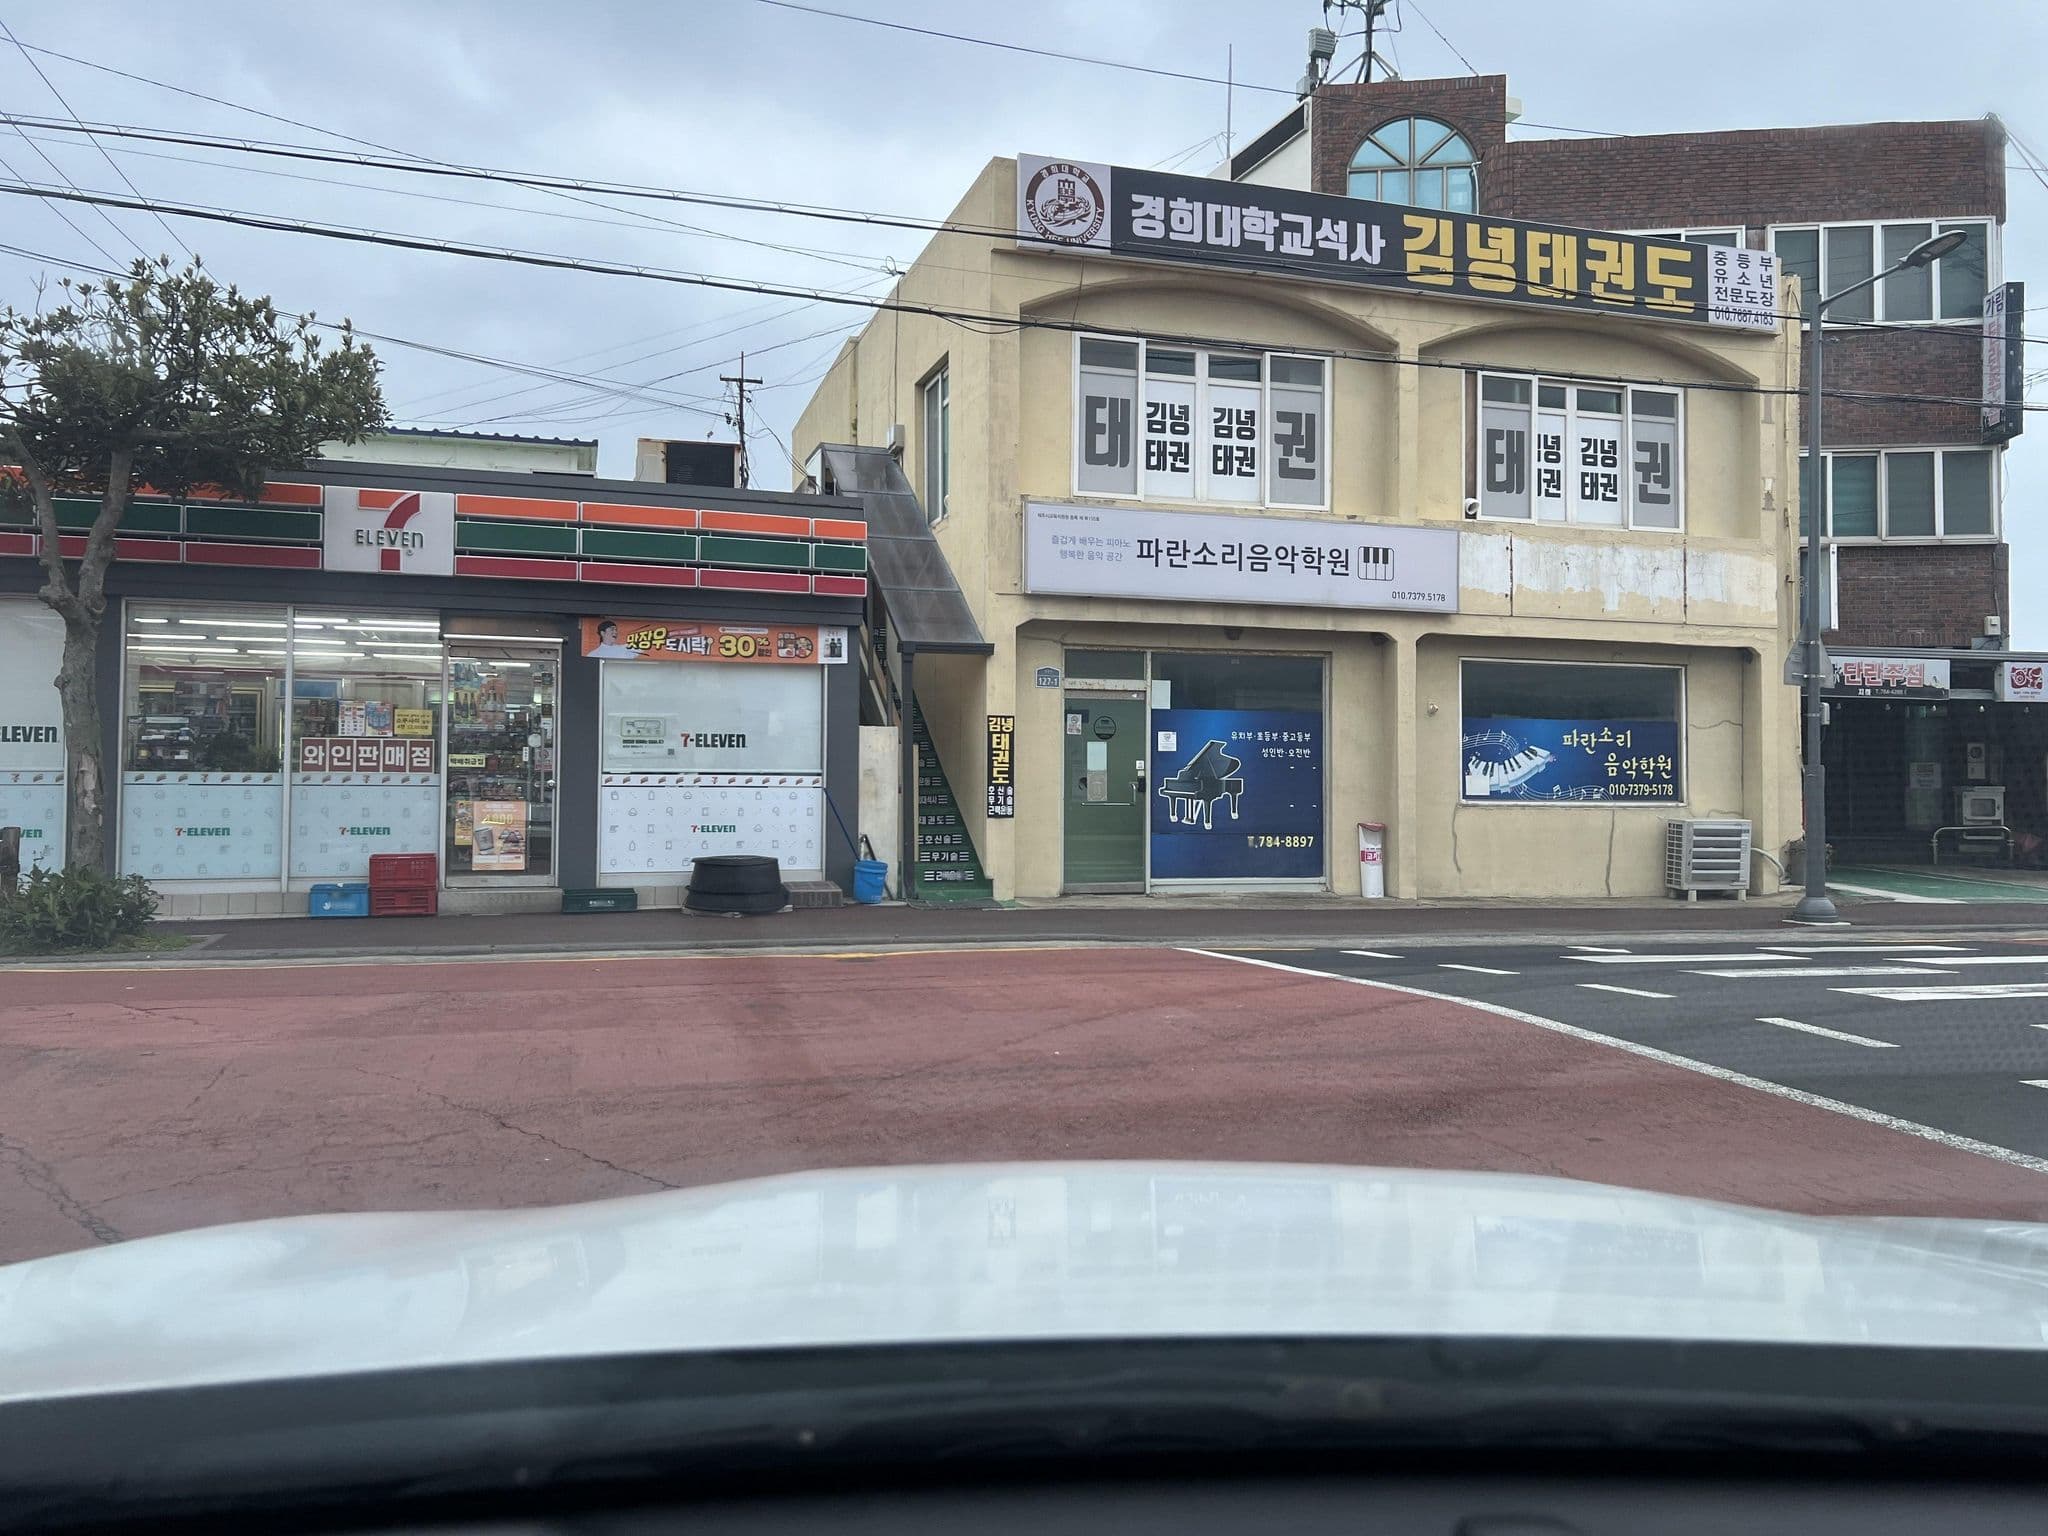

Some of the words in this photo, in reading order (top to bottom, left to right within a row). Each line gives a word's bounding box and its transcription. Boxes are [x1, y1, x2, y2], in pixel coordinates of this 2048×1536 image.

[1040, 164, 1090, 183] 경희대학교
[1026, 199, 1046, 234] KYUNG
[1130, 193, 1386, 265] 경희대학교석사
[1403, 214, 1695, 314] 김녕태권도
[1715, 286, 1774, 307] 전문도장
[1085, 395, 1131, 468] 태
[1146, 401, 1190, 436] 김녕
[1213, 407, 1256, 441] 김녕
[1145, 439, 1190, 473] 태권
[1212, 444, 1256, 478] 태권
[1273, 411, 1316, 481] 권
[1580, 437, 1618, 468] 김녕
[1486, 428, 1525, 495] 태
[1634, 441, 1671, 505] 권
[1537, 468, 1561, 498] 권
[1580, 472, 1618, 502] 태권
[1051, 534, 1077, 546] 즐겁게
[1078, 535, 1104, 547] 배우는
[1106, 537, 1132, 548] 피아노
[1059, 549, 1084, 561] 행복한
[1086, 550, 1104, 561] 음악
[1106, 551, 1123, 562] 공간
[1136, 537, 1350, 577] 파란소리음악학원
[1391, 590, 1446, 602] 010.7379.5178
[665, 636, 706, 655] 도시락
[1038, 677, 1059, 686] 127-1
[1843, 662, 1924, 687] 단란주점
[988, 716, 1014, 733] 김녕
[1563, 727, 1632, 755] 파란소리
[304, 745, 431, 767] 와인판매점
[991, 733, 1010, 784] 태권도
[1604, 752, 1673, 780] 음악학원
[1608, 783, 1673, 797] 010-7379-5178
